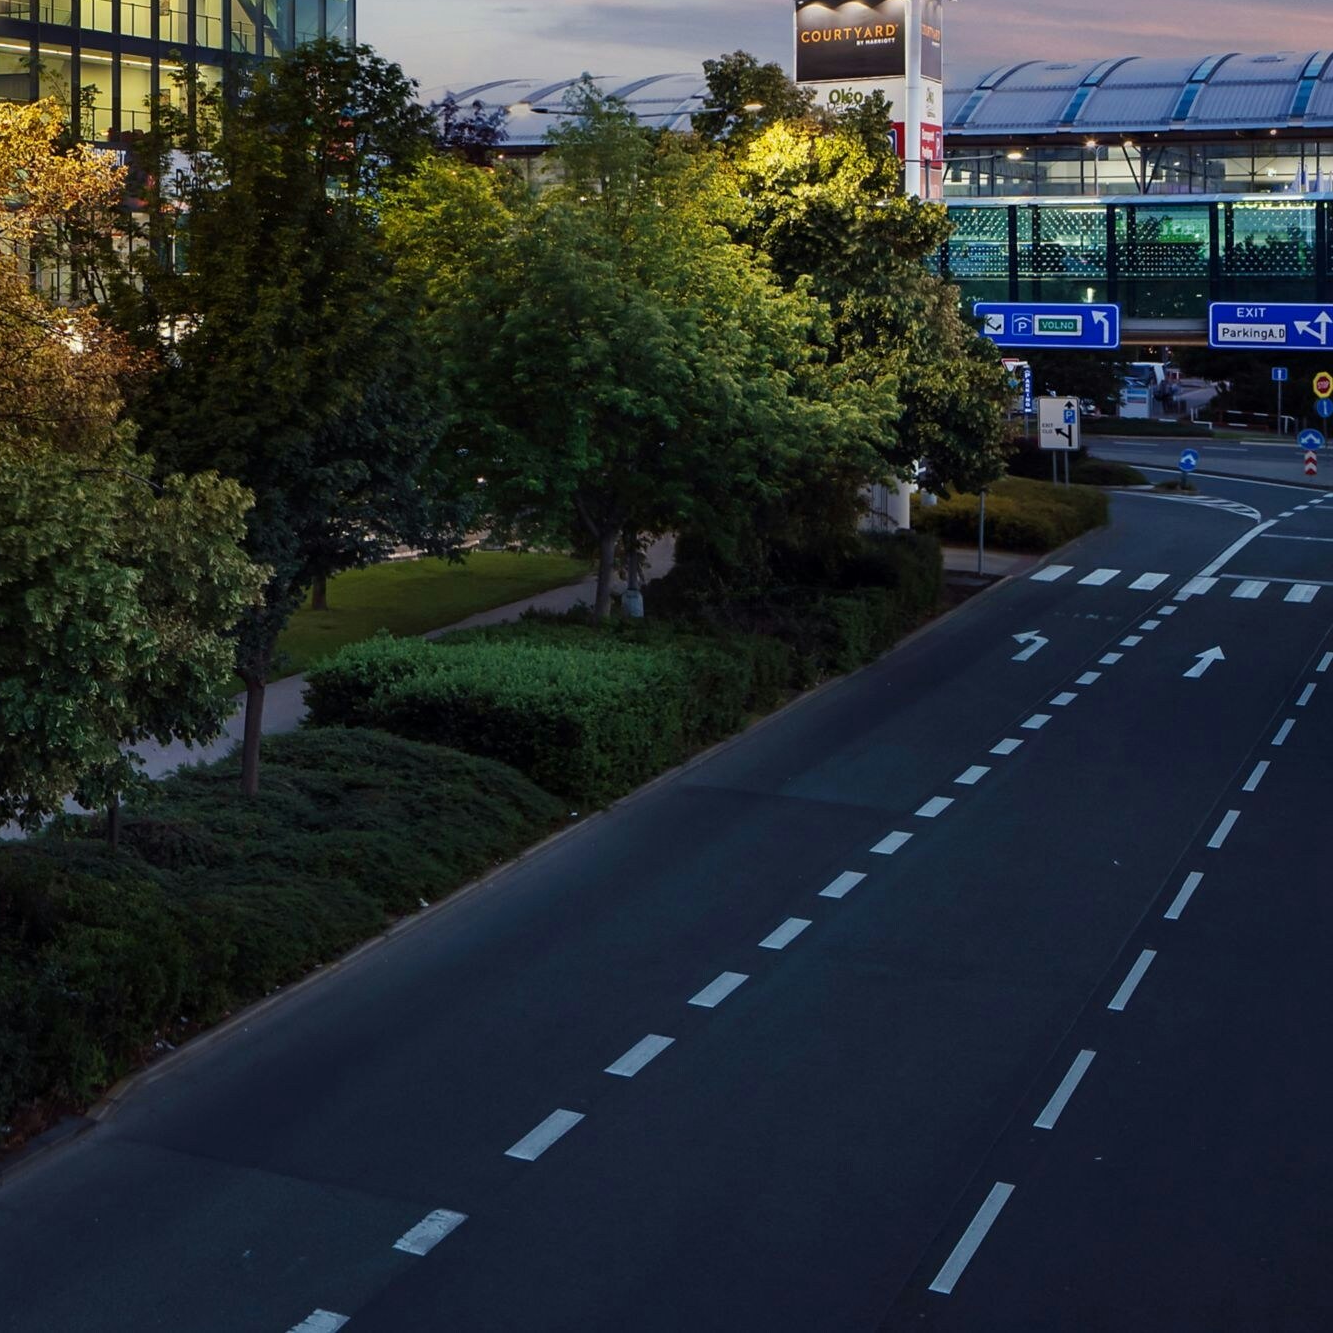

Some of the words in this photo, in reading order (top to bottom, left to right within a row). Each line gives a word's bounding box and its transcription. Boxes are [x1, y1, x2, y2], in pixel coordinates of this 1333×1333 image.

[801, 24, 896, 43] COURTYARD
[865, 37, 895, 45] MARRIOTT
[828, 86, 864, 105] Oléo
[1236, 307, 1267, 318] EXIT
[1018, 322, 1028, 332] P
[1041, 321, 1075, 330] VOLNO
[1222, 327, 1268, 341] Parking
[1065, 411, 1073, 420] P
